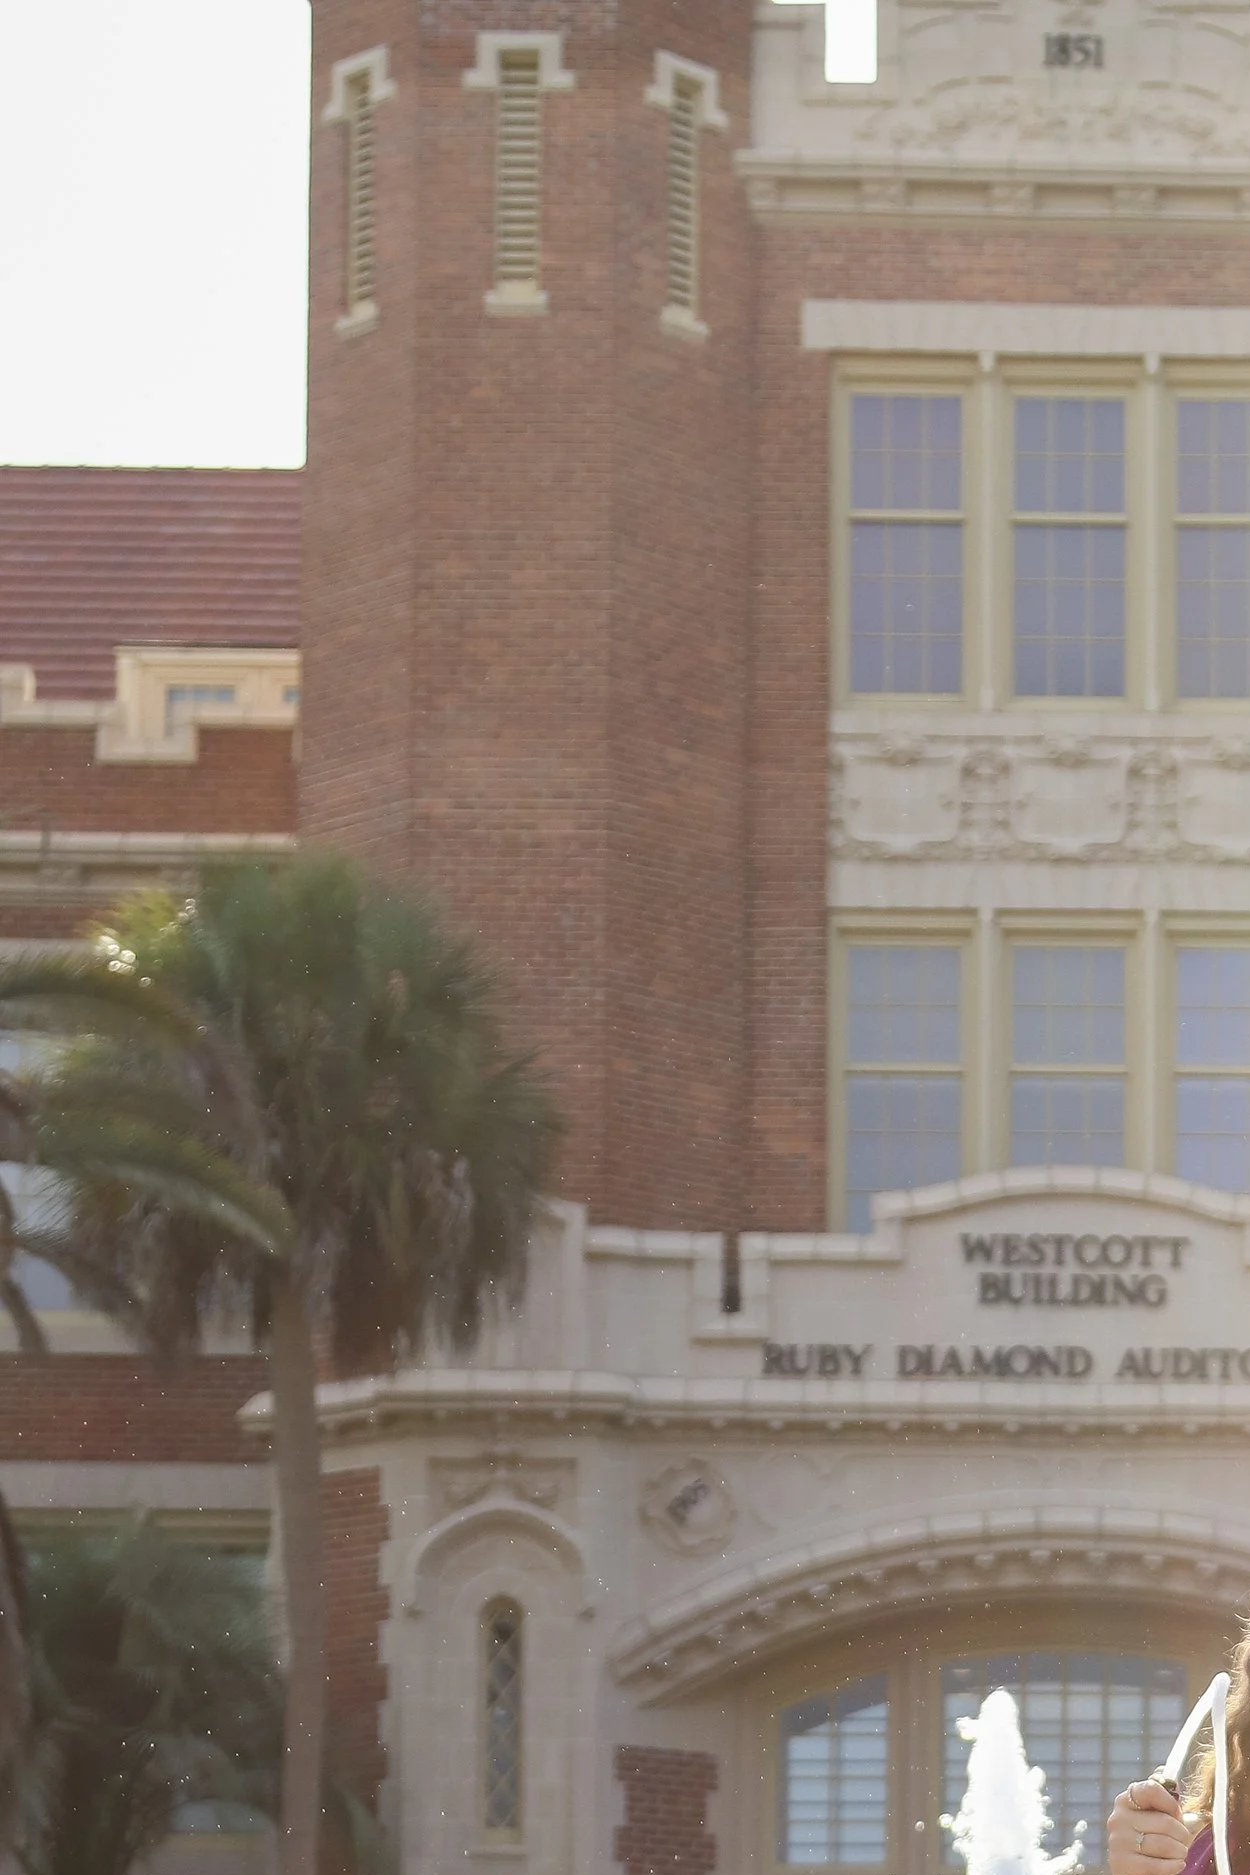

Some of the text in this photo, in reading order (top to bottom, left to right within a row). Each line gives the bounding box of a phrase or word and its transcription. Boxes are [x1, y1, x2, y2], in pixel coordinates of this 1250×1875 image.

[1043, 32, 1105, 68] 1851
[958, 1232, 1192, 1270] WESTCOTT
[976, 1271, 1168, 1307] BUILDING
[761, 1342, 873, 1376] RUBY
[896, 1344, 1093, 1378] DIAMOND
